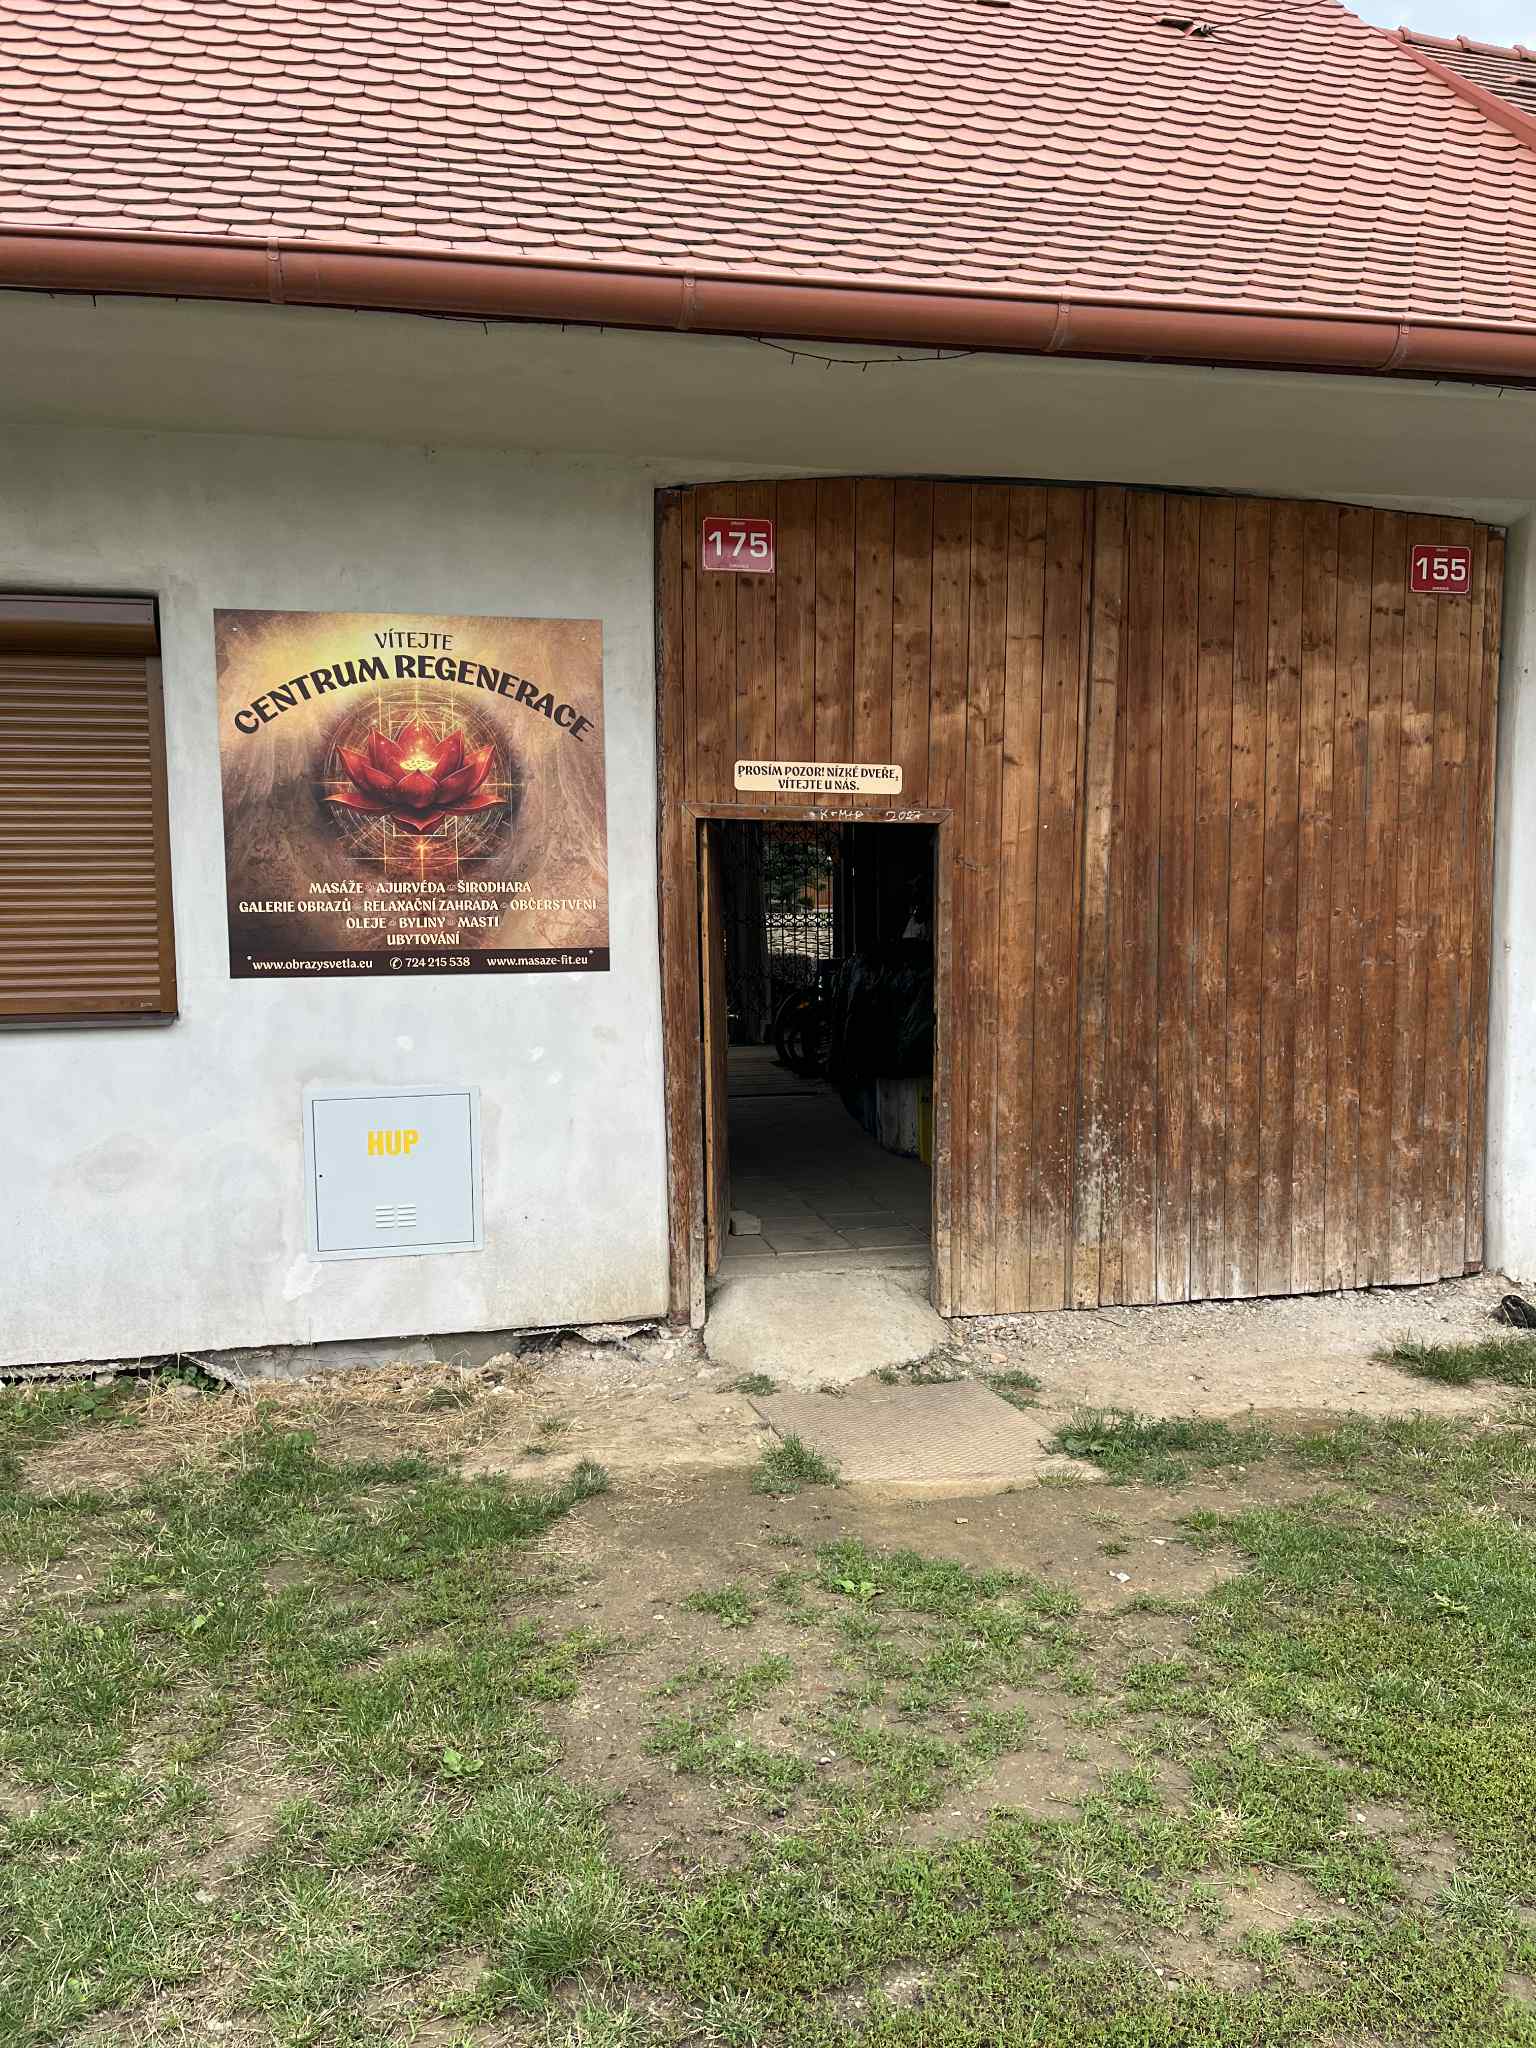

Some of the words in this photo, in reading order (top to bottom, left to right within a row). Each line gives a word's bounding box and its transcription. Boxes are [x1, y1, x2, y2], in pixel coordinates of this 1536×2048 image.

[708, 530, 769, 558] 175
[1415, 557, 1466, 581] 155
[374, 627, 455, 651] VÍTEJTE
[234, 655, 390, 734] CENTRUM
[394, 654, 595, 742] REGENERACE
[738, 764, 783, 776] PROSÍM
[785, 766, 825, 777] POZOR!
[827, 765, 859, 778] NÍZKÉ
[778, 777, 822, 790] VÍTEJTE
[824, 779, 832, 790] U
[834, 778, 860, 791] NÁS.
[309, 880, 364, 894] MASÁŽE
[376, 880, 446, 894] AJURVÉDA
[457, 879, 532, 893] ŠIRODHARA
[238, 900, 295, 913] GALERIE
[297, 898, 351, 912] OBRAZŮ
[363, 897, 436, 912] RELAXAČNÍ
[438, 899, 499, 911] ZAHRADA
[510, 896, 597, 911] OBČERSTVENÍ
[346, 917, 387, 929] OLEJE
[399, 917, 446, 929] BYLINY
[457, 916, 499, 928] MASTI
[386, 930, 460, 945] UBYTOVÁNÍ
[252, 958, 373, 972] www.obrazysvetla.eu
[405, 958, 427, 968] 724
[428, 957, 447, 967] 215
[449, 956, 470, 967] 538
[486, 955, 588, 967] www.masaze-fit.eu
[367, 1128, 420, 1157] HUP
